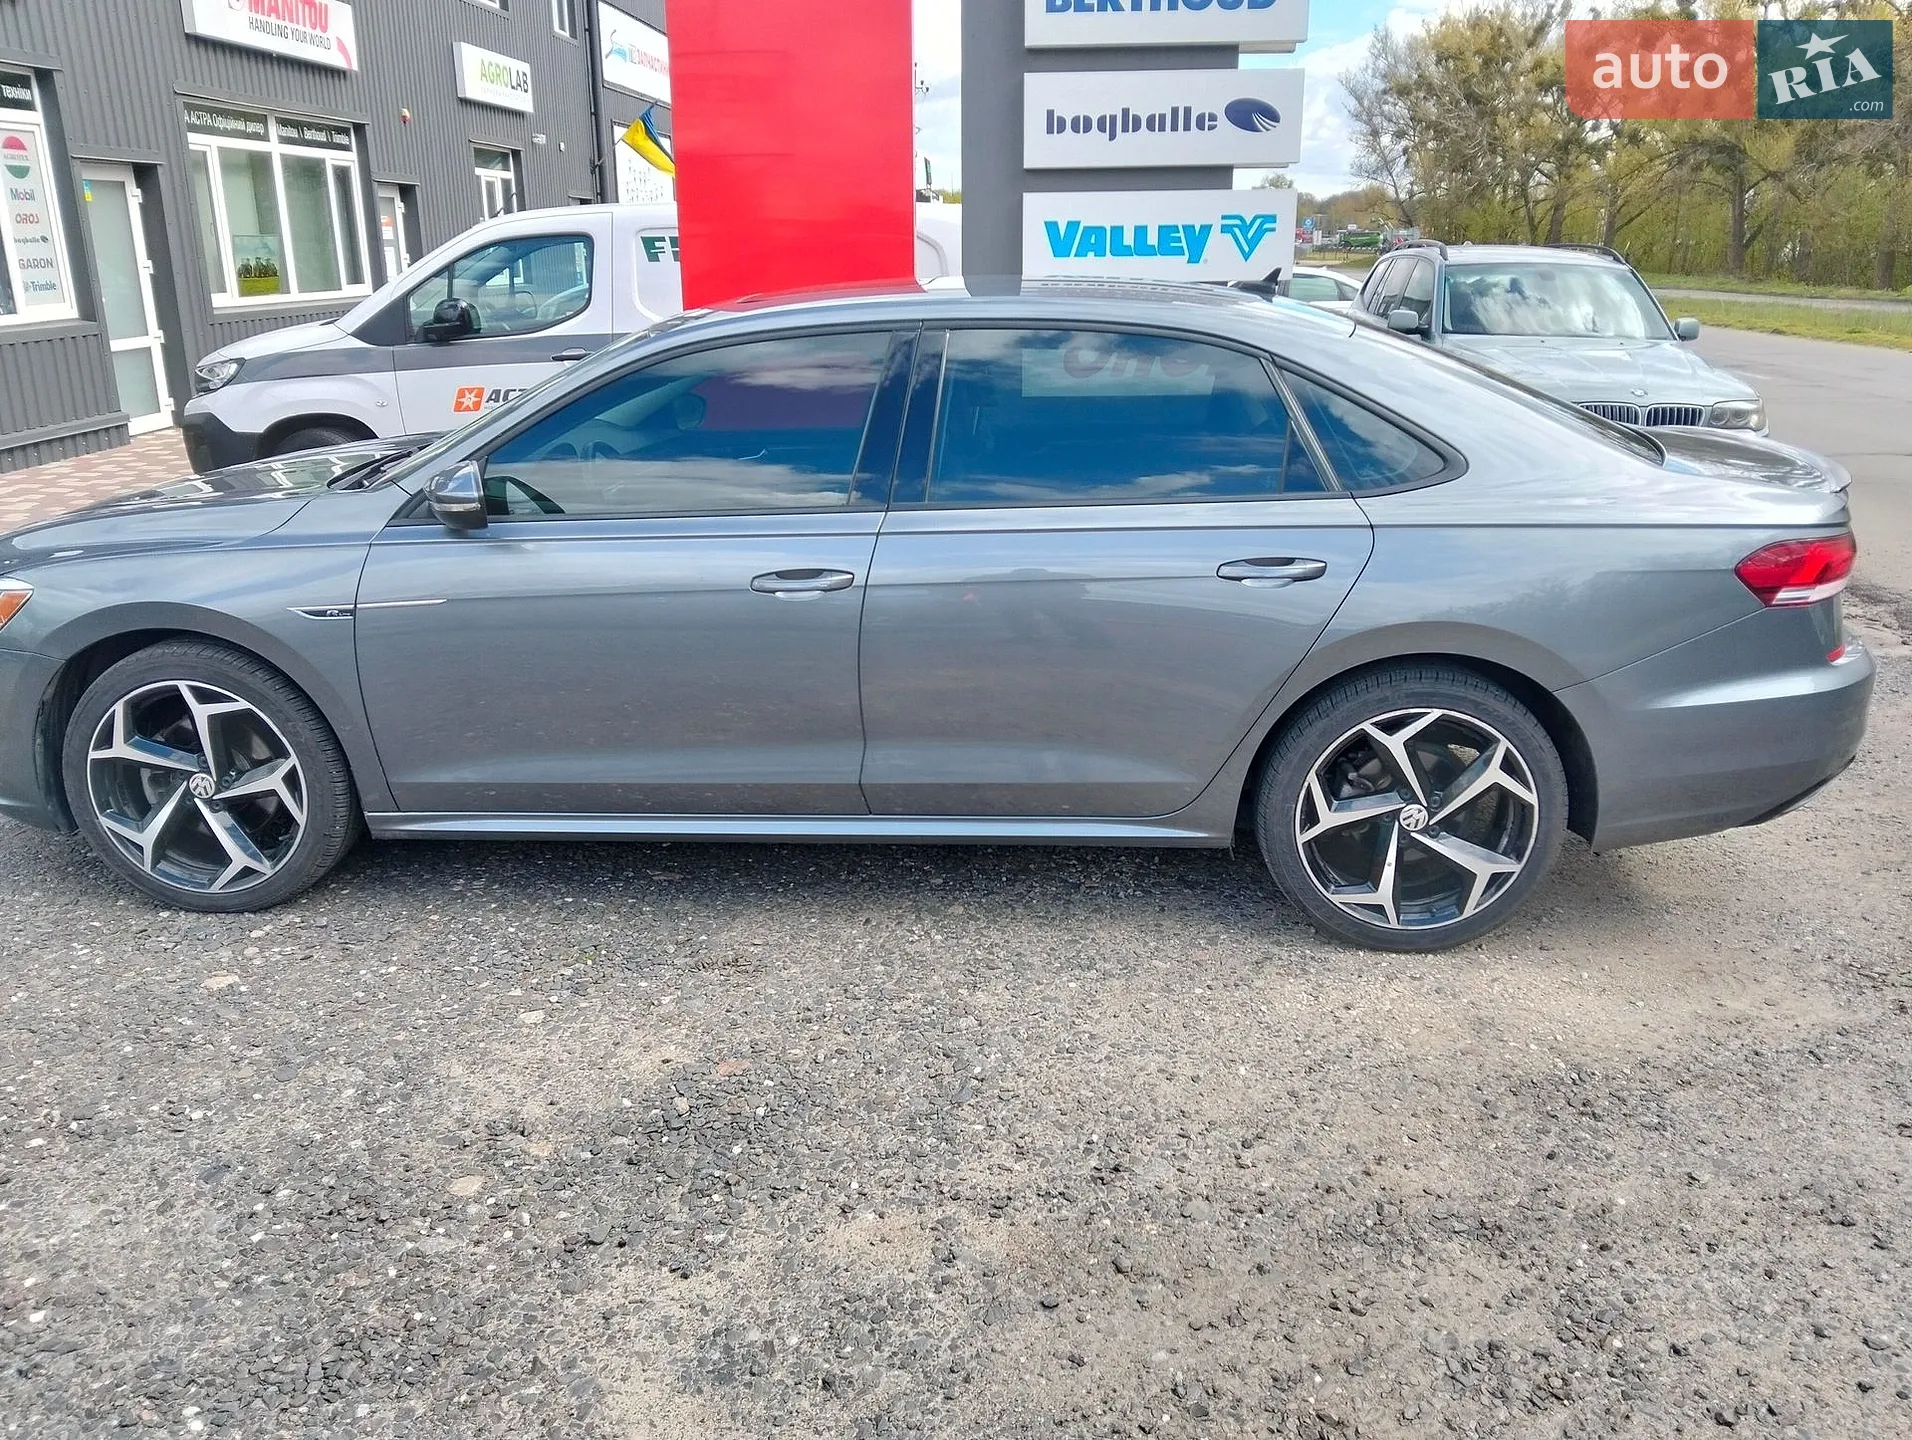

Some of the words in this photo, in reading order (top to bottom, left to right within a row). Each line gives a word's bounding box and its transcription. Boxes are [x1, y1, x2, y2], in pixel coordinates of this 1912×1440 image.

[248, 16, 289, 40] HANDLING
[290, 27, 308, 44] YOUR
[308, 32, 332, 51] WORLD
[480, 58, 529, 93] AGROLAB
[190, 110, 212, 126] АСТРА
[10, 187, 35, 201] Mobil
[18, 258, 54, 270] GARON
[31, 281, 57, 291] Trimble
